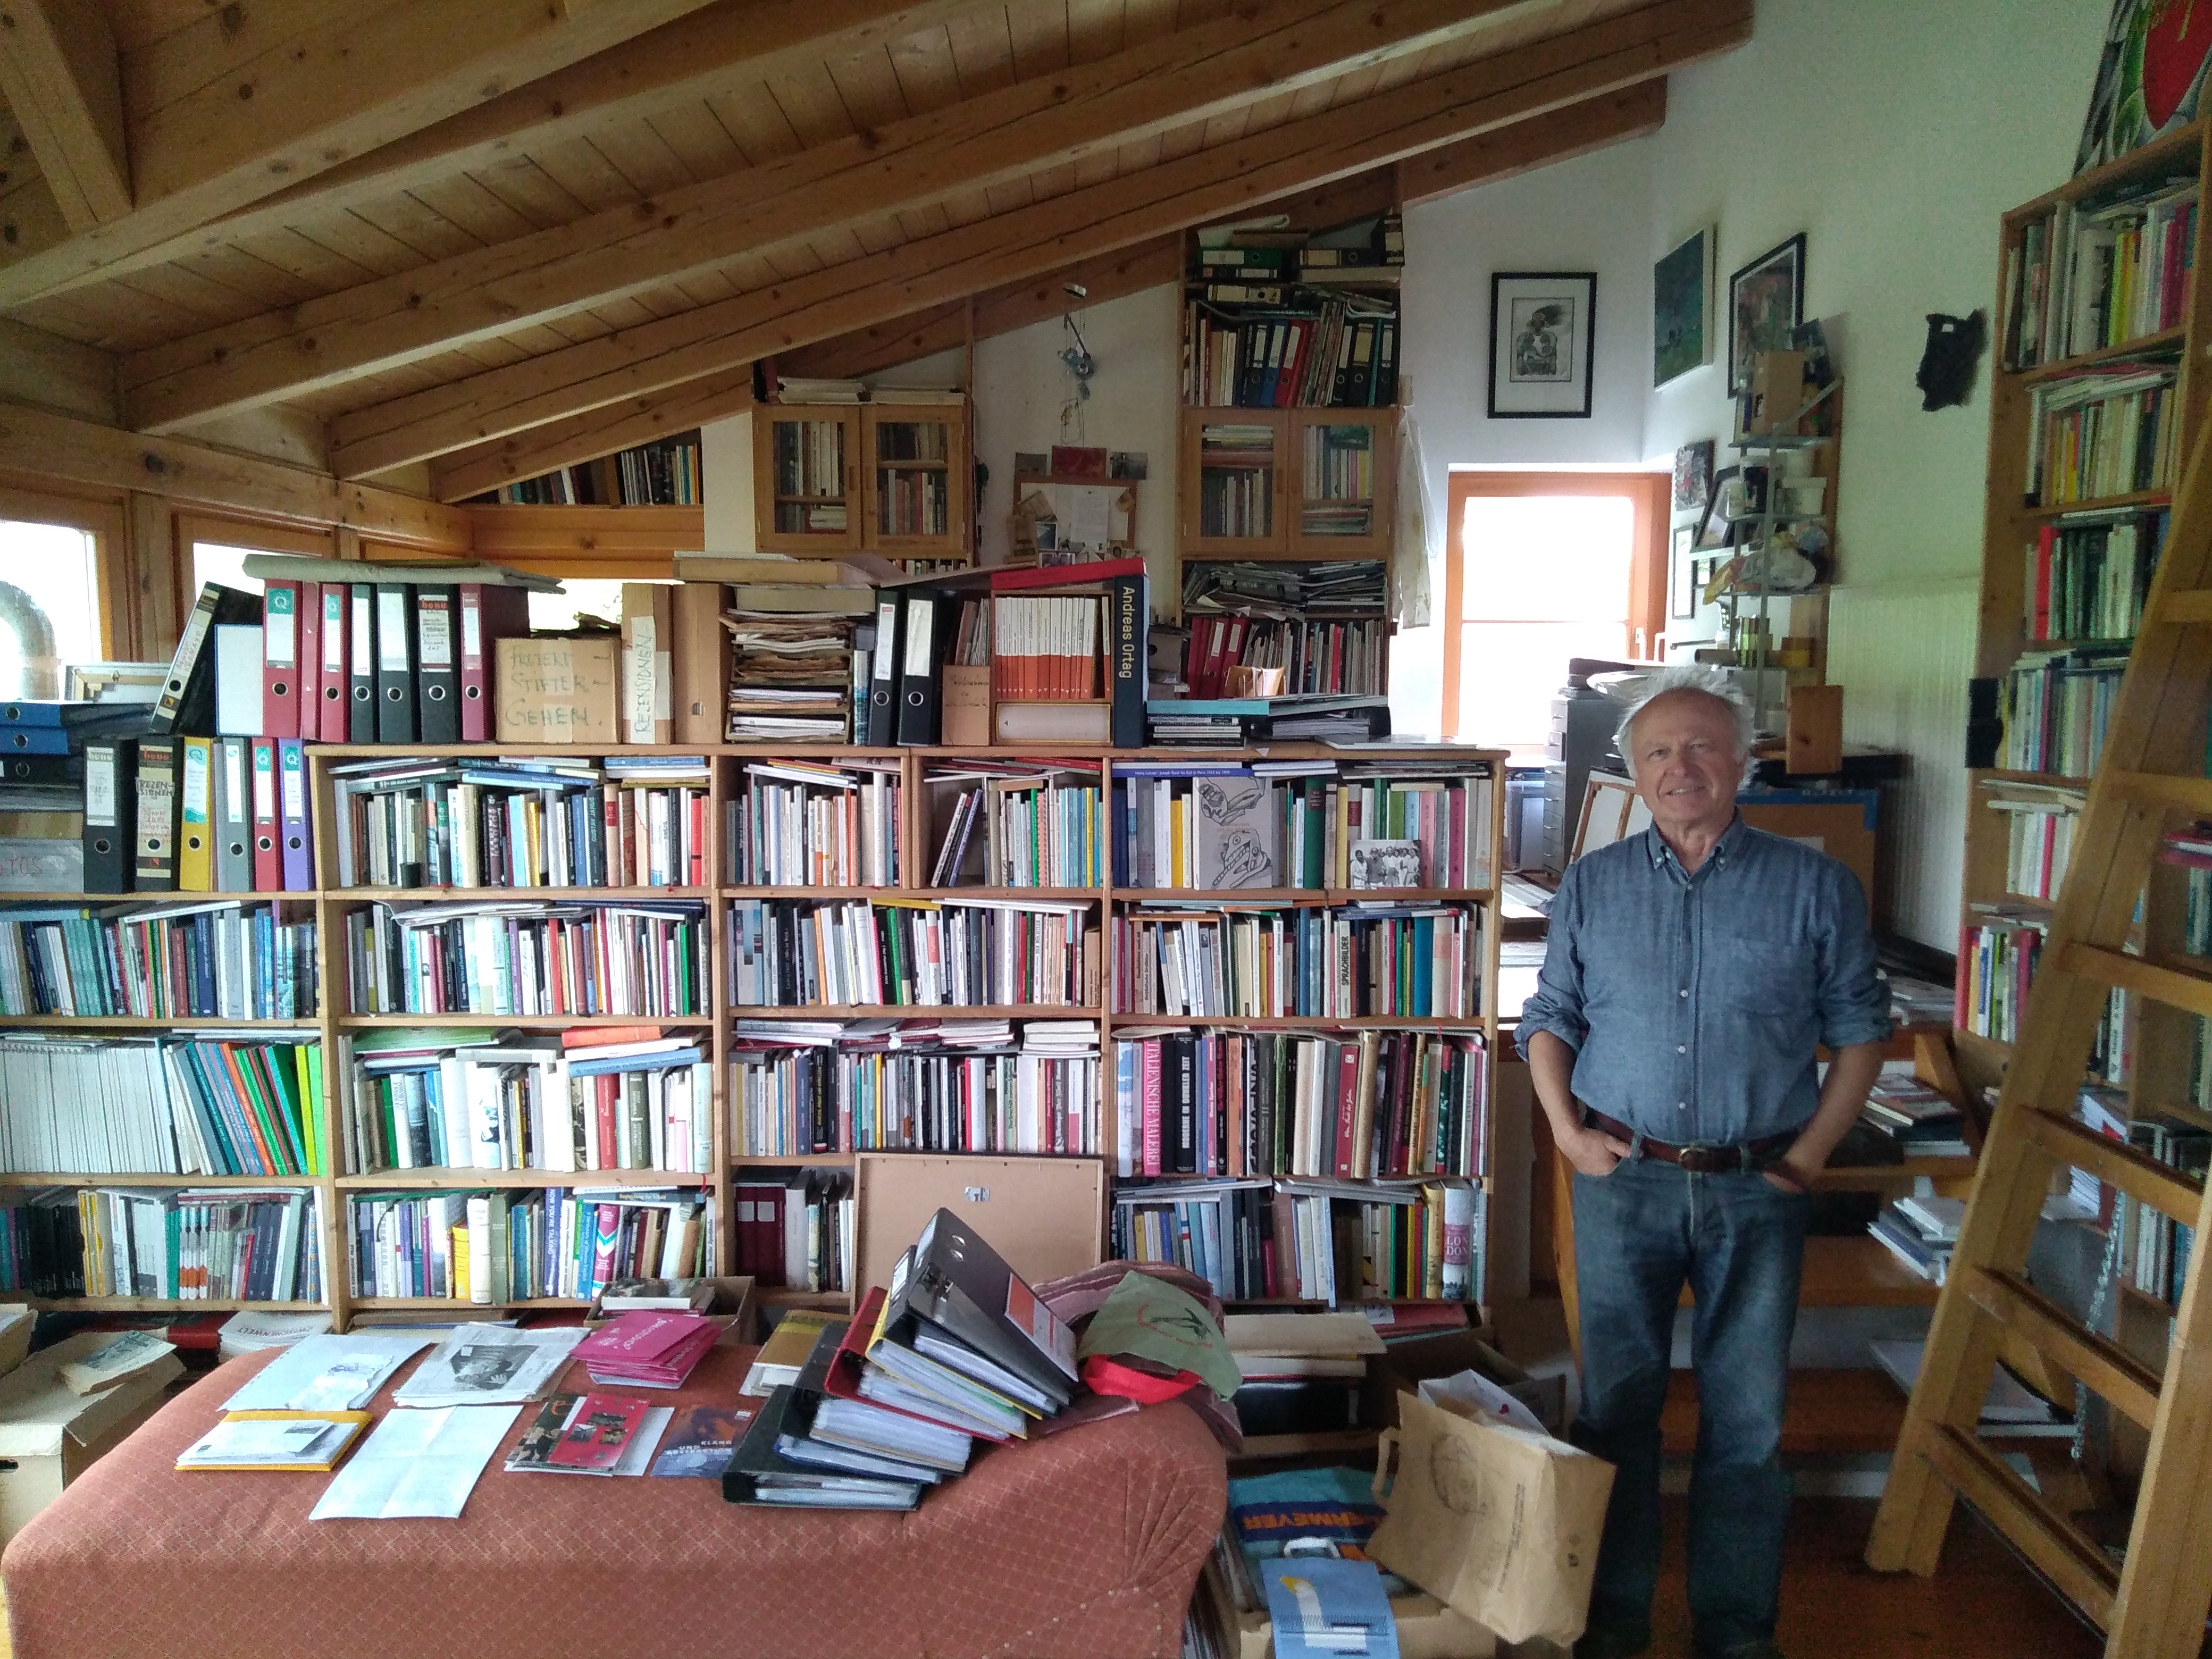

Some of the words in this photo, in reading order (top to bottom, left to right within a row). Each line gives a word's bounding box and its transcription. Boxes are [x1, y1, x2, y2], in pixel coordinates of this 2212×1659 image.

[1122, 586, 1135, 641] Andreas
[1119, 644, 1135, 679] Ortag
[511, 672, 589, 693] STIFTER
[634, 636, 653, 734] REZENSIONEN
[1340, 936, 1350, 986] SPRACHBILDER
[1146, 1043, 1160, 1116] ITALIENISCHE
[1182, 1055, 1190, 1071] ZEIT
[1182, 1073, 1190, 1104] DUNKLER
[1146, 1118, 1160, 1166] MALEREI
[1182, 1116, 1191, 1149] MODERNE
